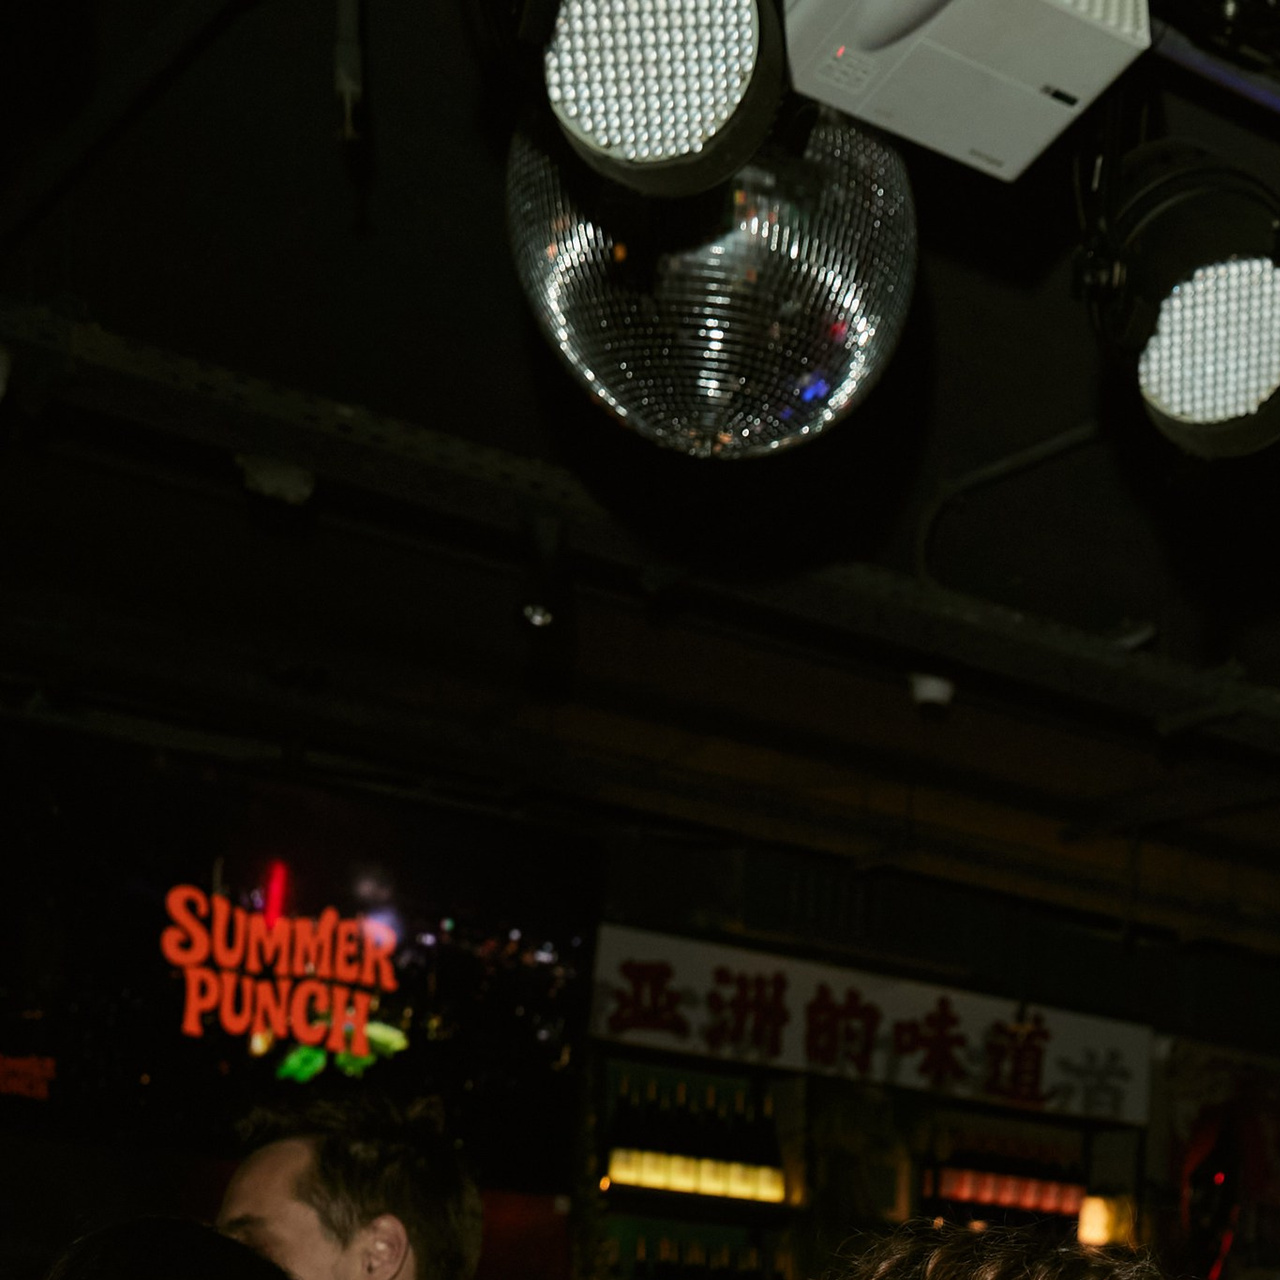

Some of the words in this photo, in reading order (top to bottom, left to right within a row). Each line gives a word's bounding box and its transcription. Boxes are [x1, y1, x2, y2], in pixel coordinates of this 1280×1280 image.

[161, 884, 398, 992] SUMMER
[180, 966, 374, 1057] PUNCH
[609, 958, 1050, 1111] 亚洲的味道
